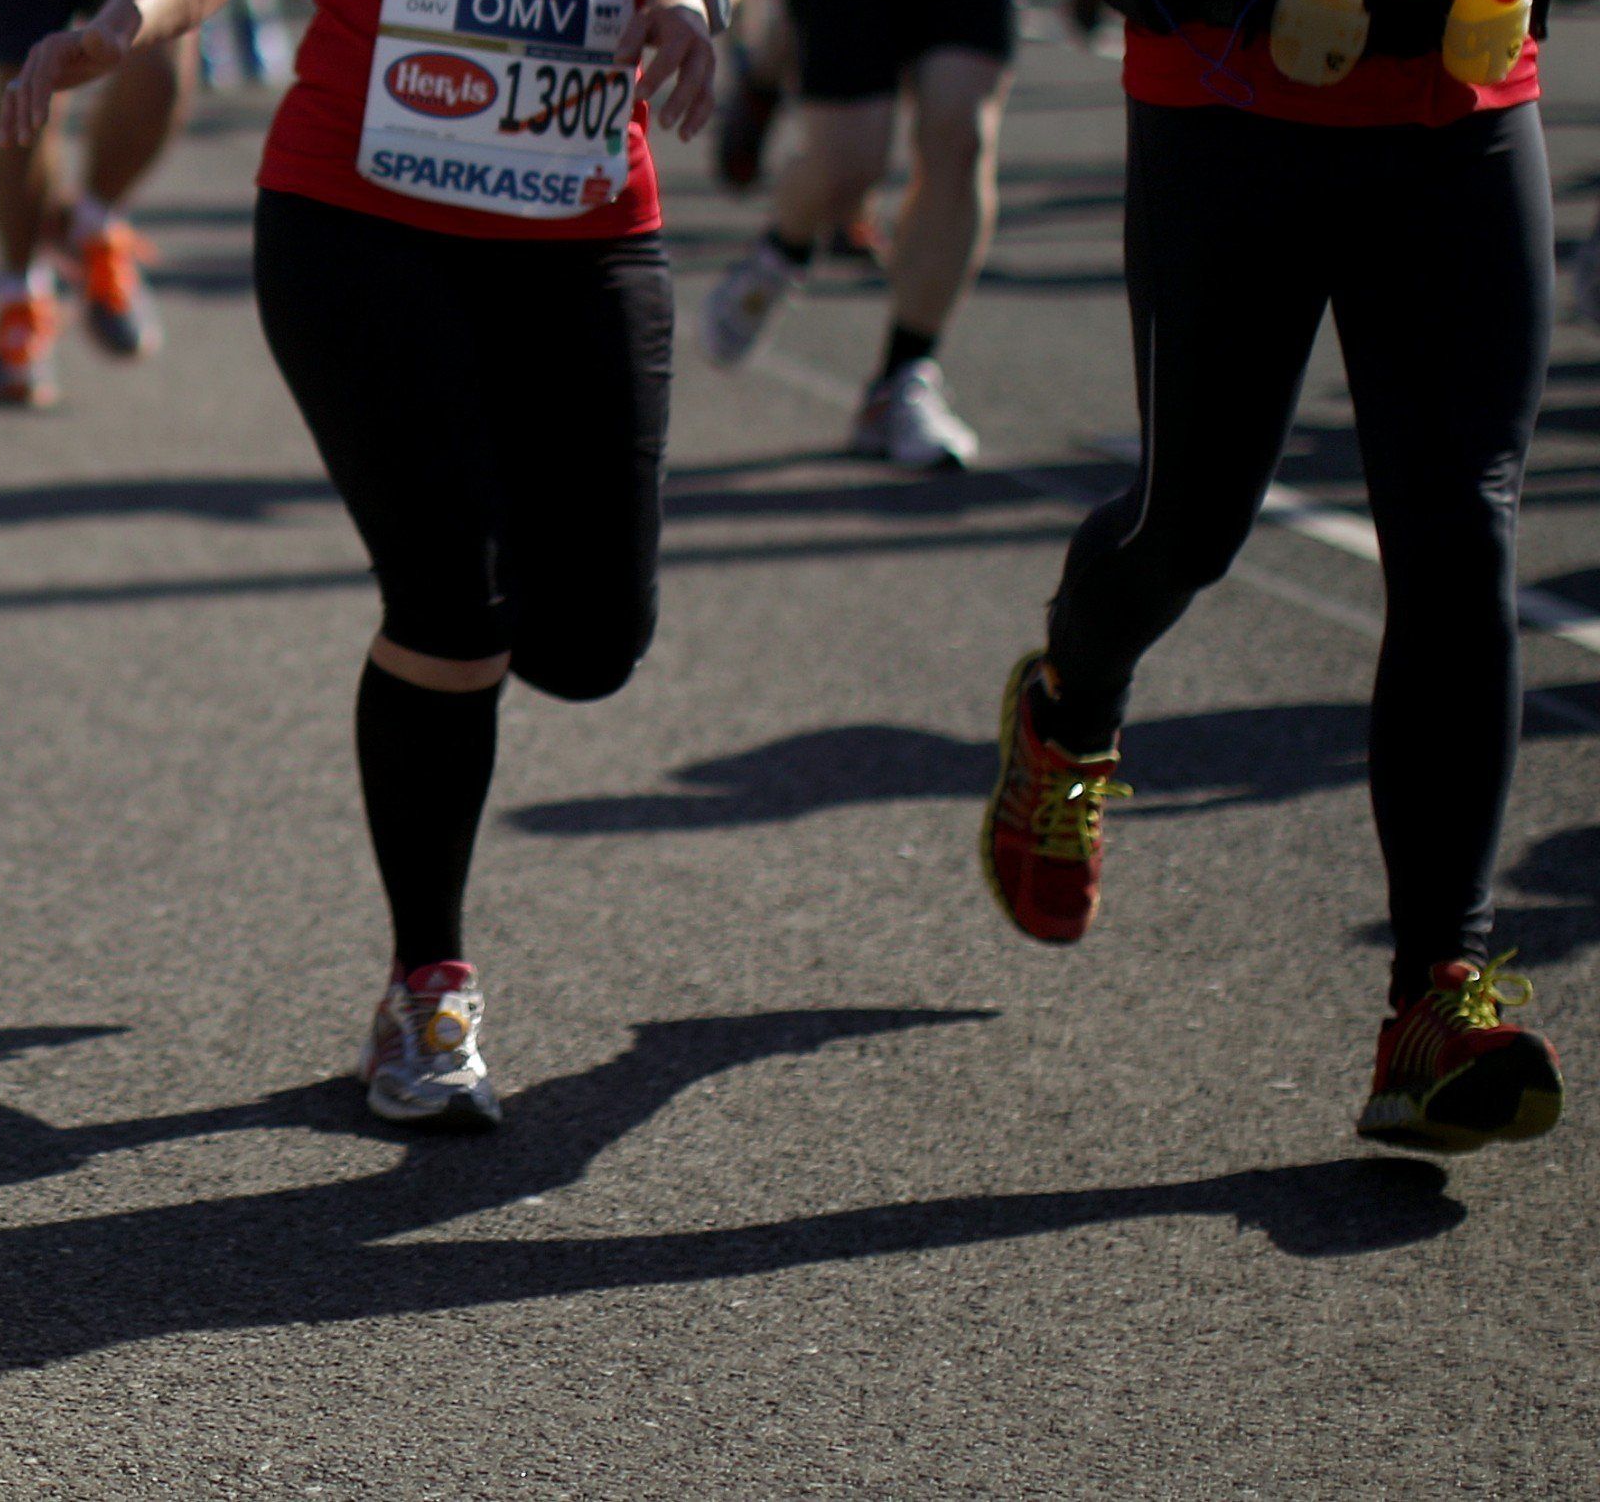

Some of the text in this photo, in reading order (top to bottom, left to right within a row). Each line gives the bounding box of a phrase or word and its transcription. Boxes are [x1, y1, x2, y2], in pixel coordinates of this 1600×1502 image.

[396, 62, 488, 107] Hervis
[498, 61, 630, 140] 13002
[371, 149, 580, 206] SPARKASSE
